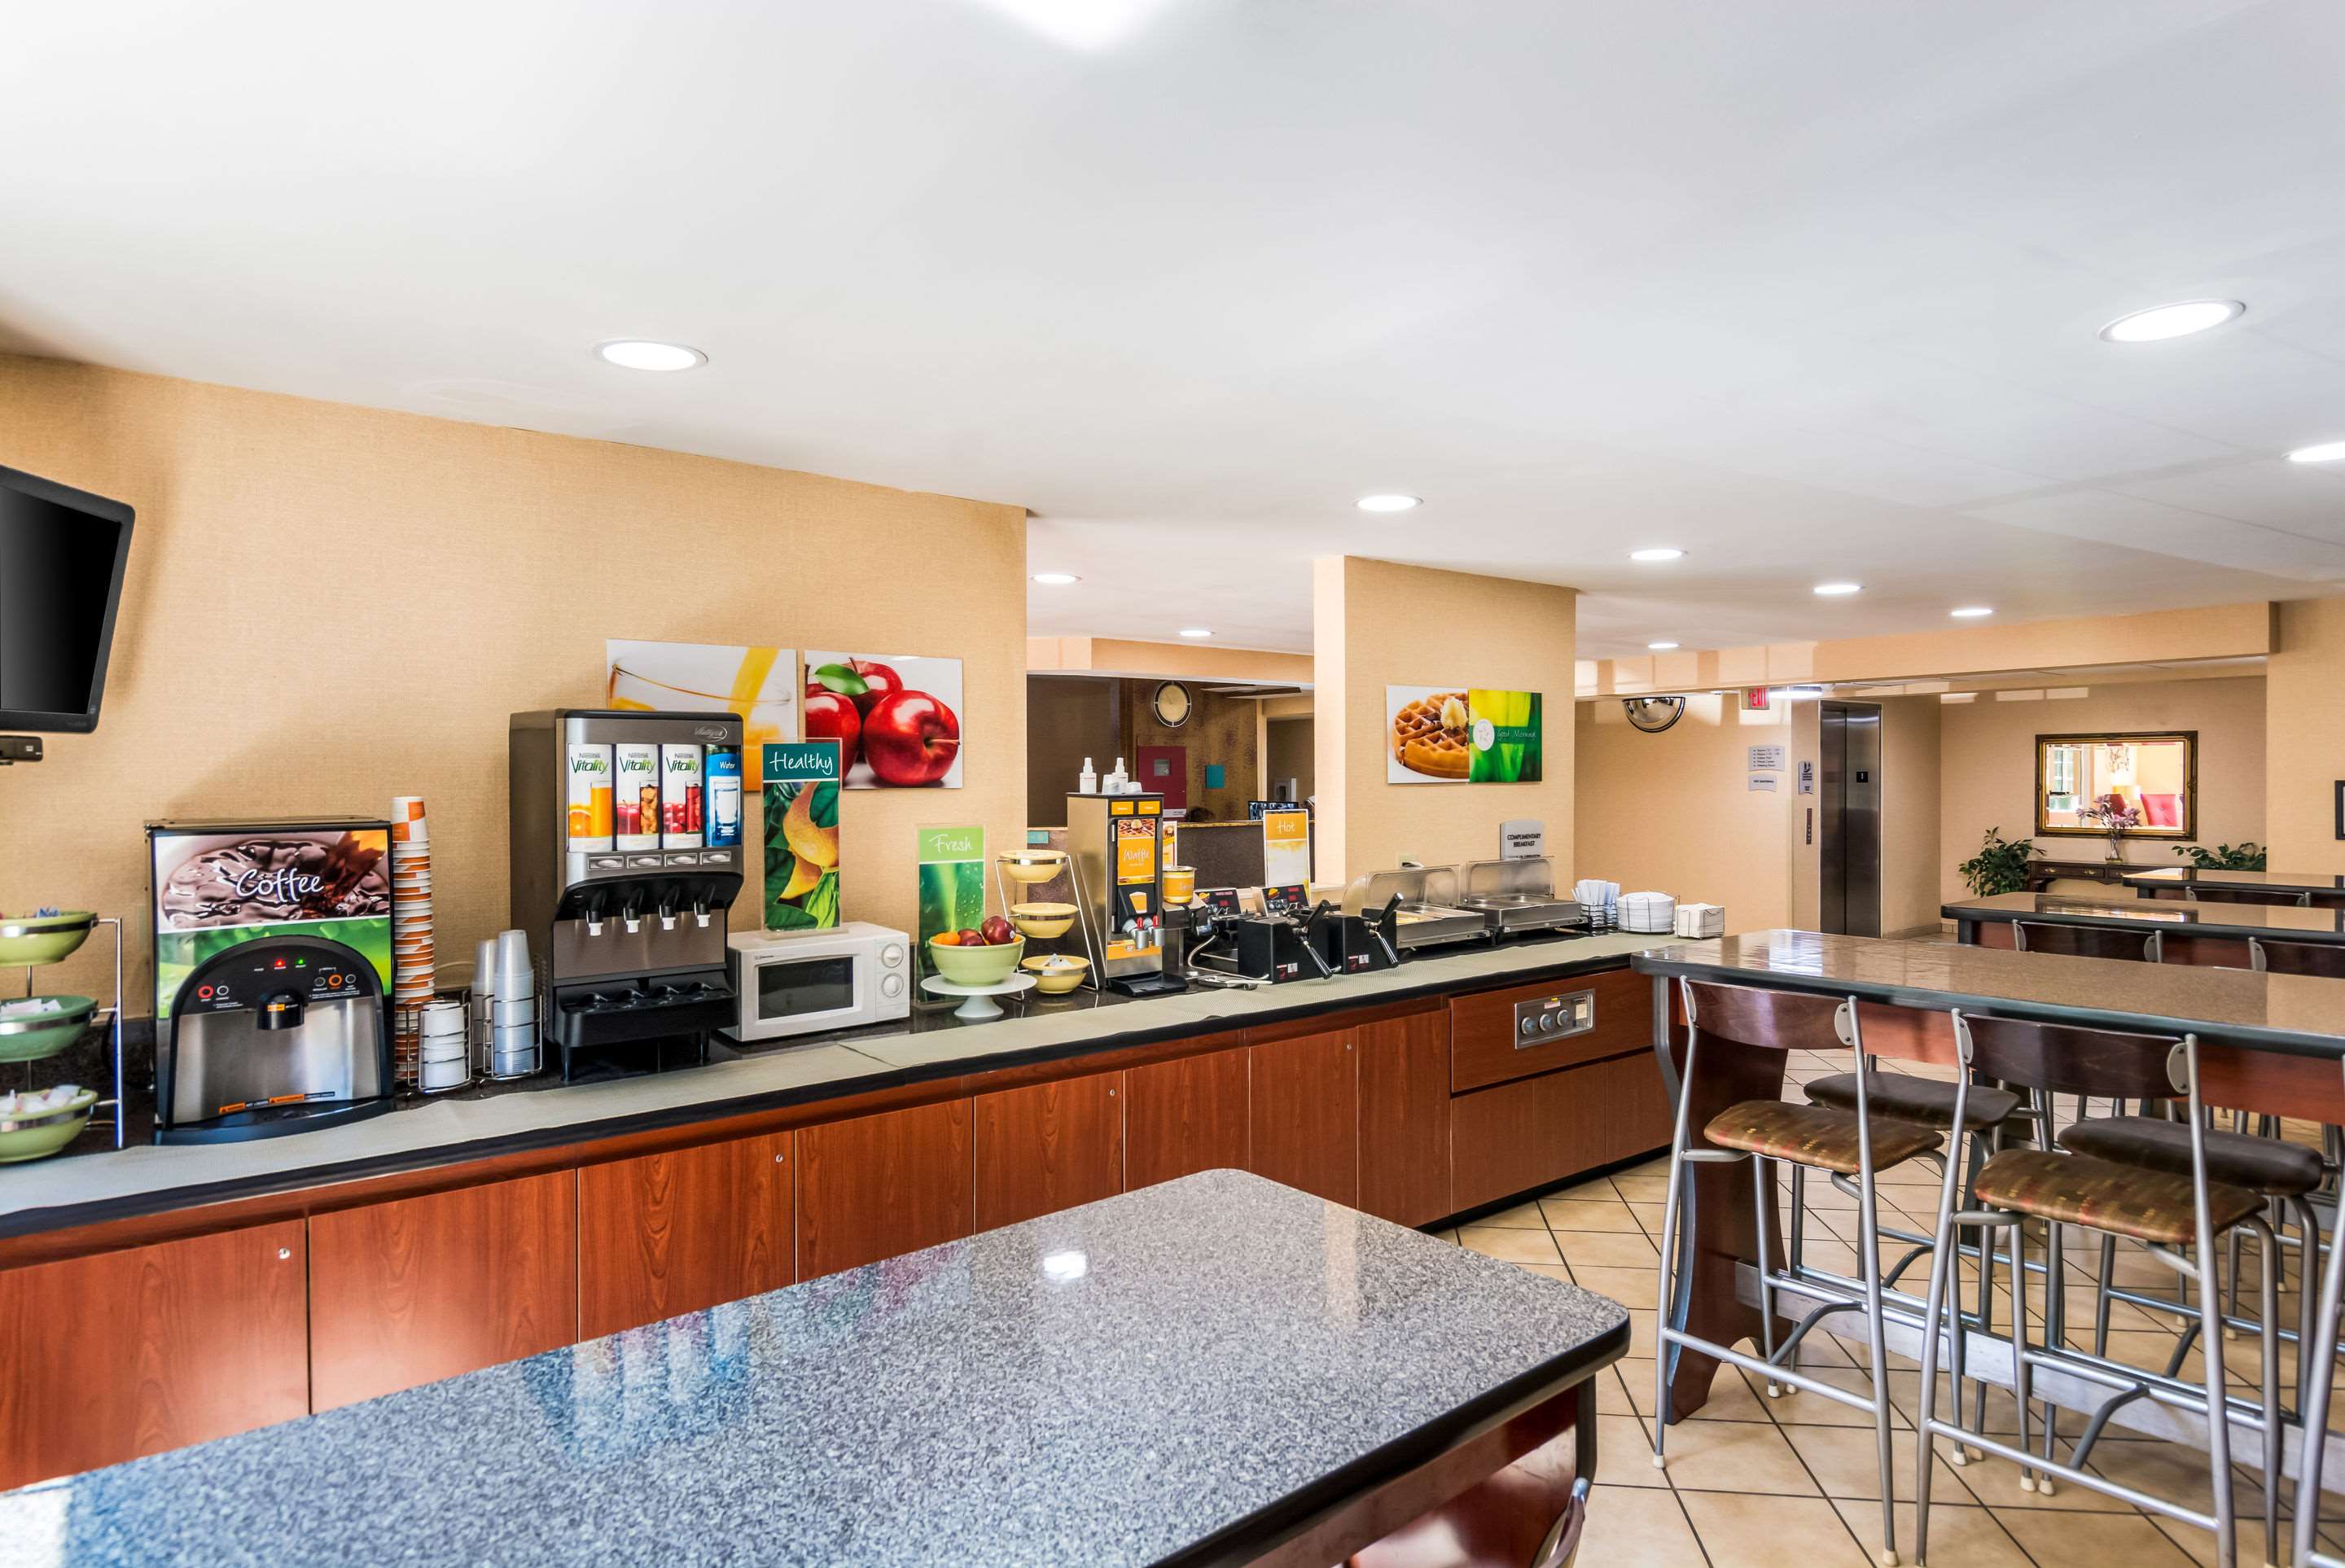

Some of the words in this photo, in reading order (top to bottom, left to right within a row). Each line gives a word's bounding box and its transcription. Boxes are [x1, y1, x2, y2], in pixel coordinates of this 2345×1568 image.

[571, 756, 609, 774] Vitality
[619, 756, 656, 774] Vitality
[666, 756, 700, 774] Vitality
[720, 761, 736, 769] Water
[769, 751, 833, 776] Healthy
[1276, 820, 1296, 834] Hot
[928, 834, 974, 854] Fresh
[1123, 847, 1151, 861] Waffle
[236, 867, 324, 902] Coffee
